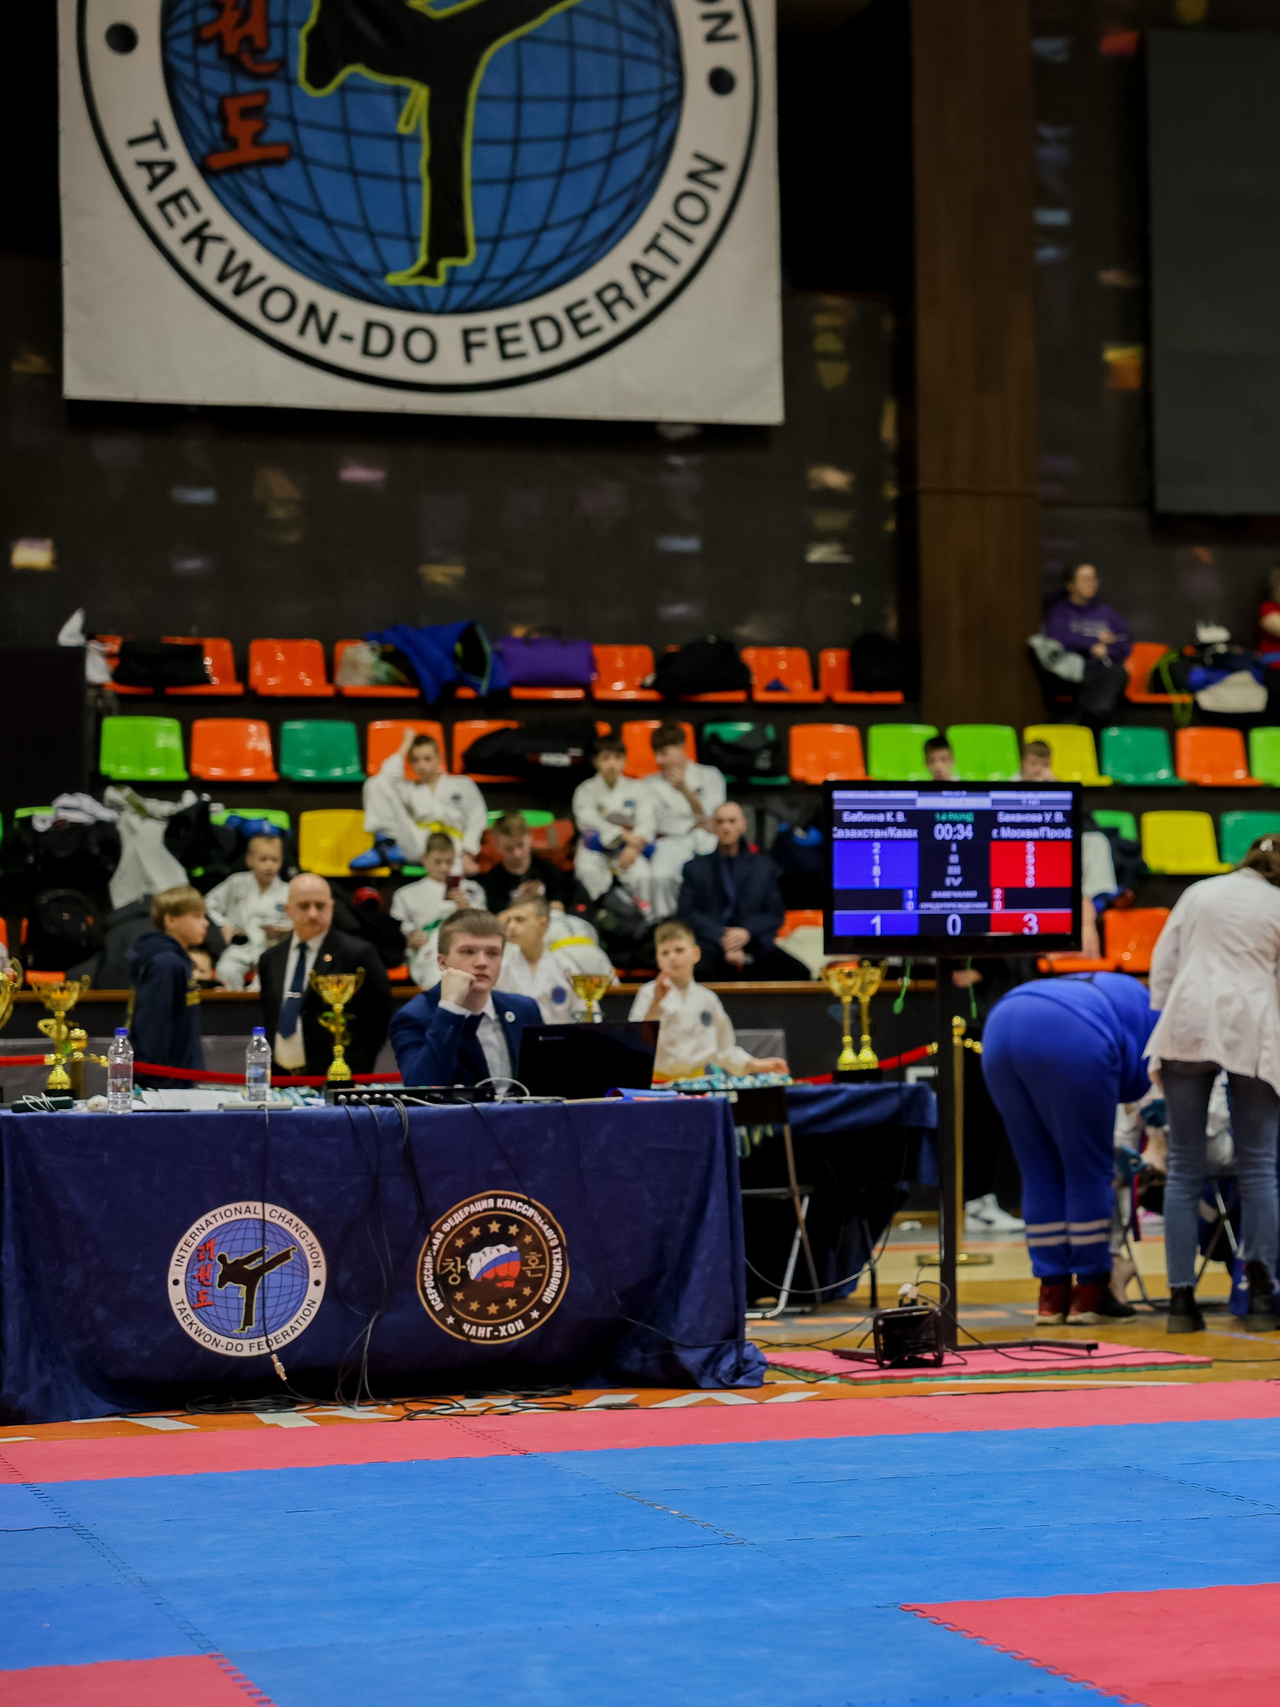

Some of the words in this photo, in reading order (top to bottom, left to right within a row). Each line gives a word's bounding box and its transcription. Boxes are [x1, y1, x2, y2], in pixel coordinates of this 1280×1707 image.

[126, 119, 439, 365] TAEKWON-DO
[462, 152, 729, 366] FEDERATION
[933, 823, 974, 840] 00:34
[870, 914, 882, 936] 1
[946, 912, 962, 936] 0
[1022, 912, 1039, 935] 3
[442, 1198, 495, 1232] ФЕДЕРАЦИЯ
[174, 1205, 260, 1268] INTERNATIONAL
[269, 1208, 322, 1269] CHANG-HON
[192, 1237, 216, 1309] 태권도
[440, 1256, 466, 1285] 창
[175, 1298, 244, 1353] TAEKWON-DO
[249, 1298, 317, 1353] FEDERATION
[462, 1318, 525, 1338] ЧАНГ-ХОН
